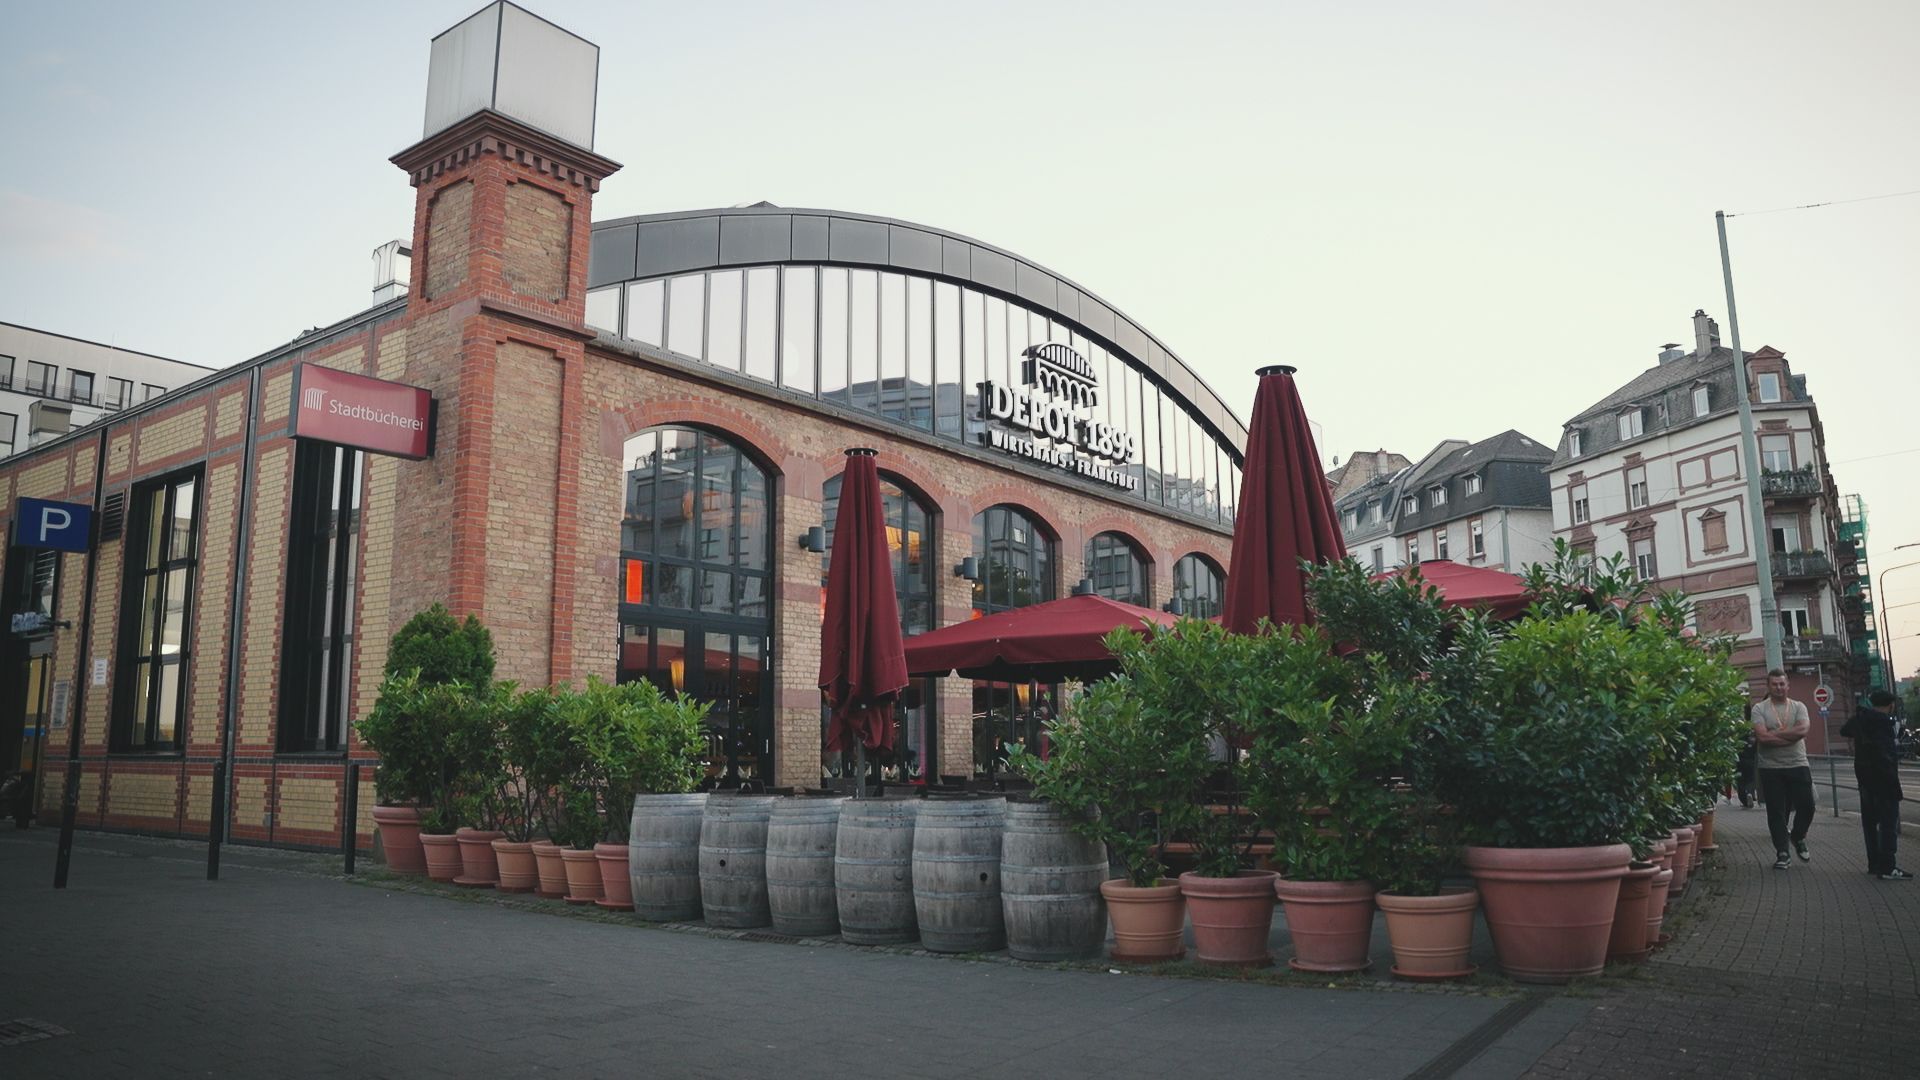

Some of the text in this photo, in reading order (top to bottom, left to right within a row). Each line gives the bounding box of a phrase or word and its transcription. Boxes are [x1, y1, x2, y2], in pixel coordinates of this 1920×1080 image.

[329, 400, 424, 431] Stadtbücherei
[991, 380, 1136, 463] DEPOT 1899
[991, 429, 1139, 490] WIRTSHAUS FRANKFURT
[40, 507, 71, 541] P
